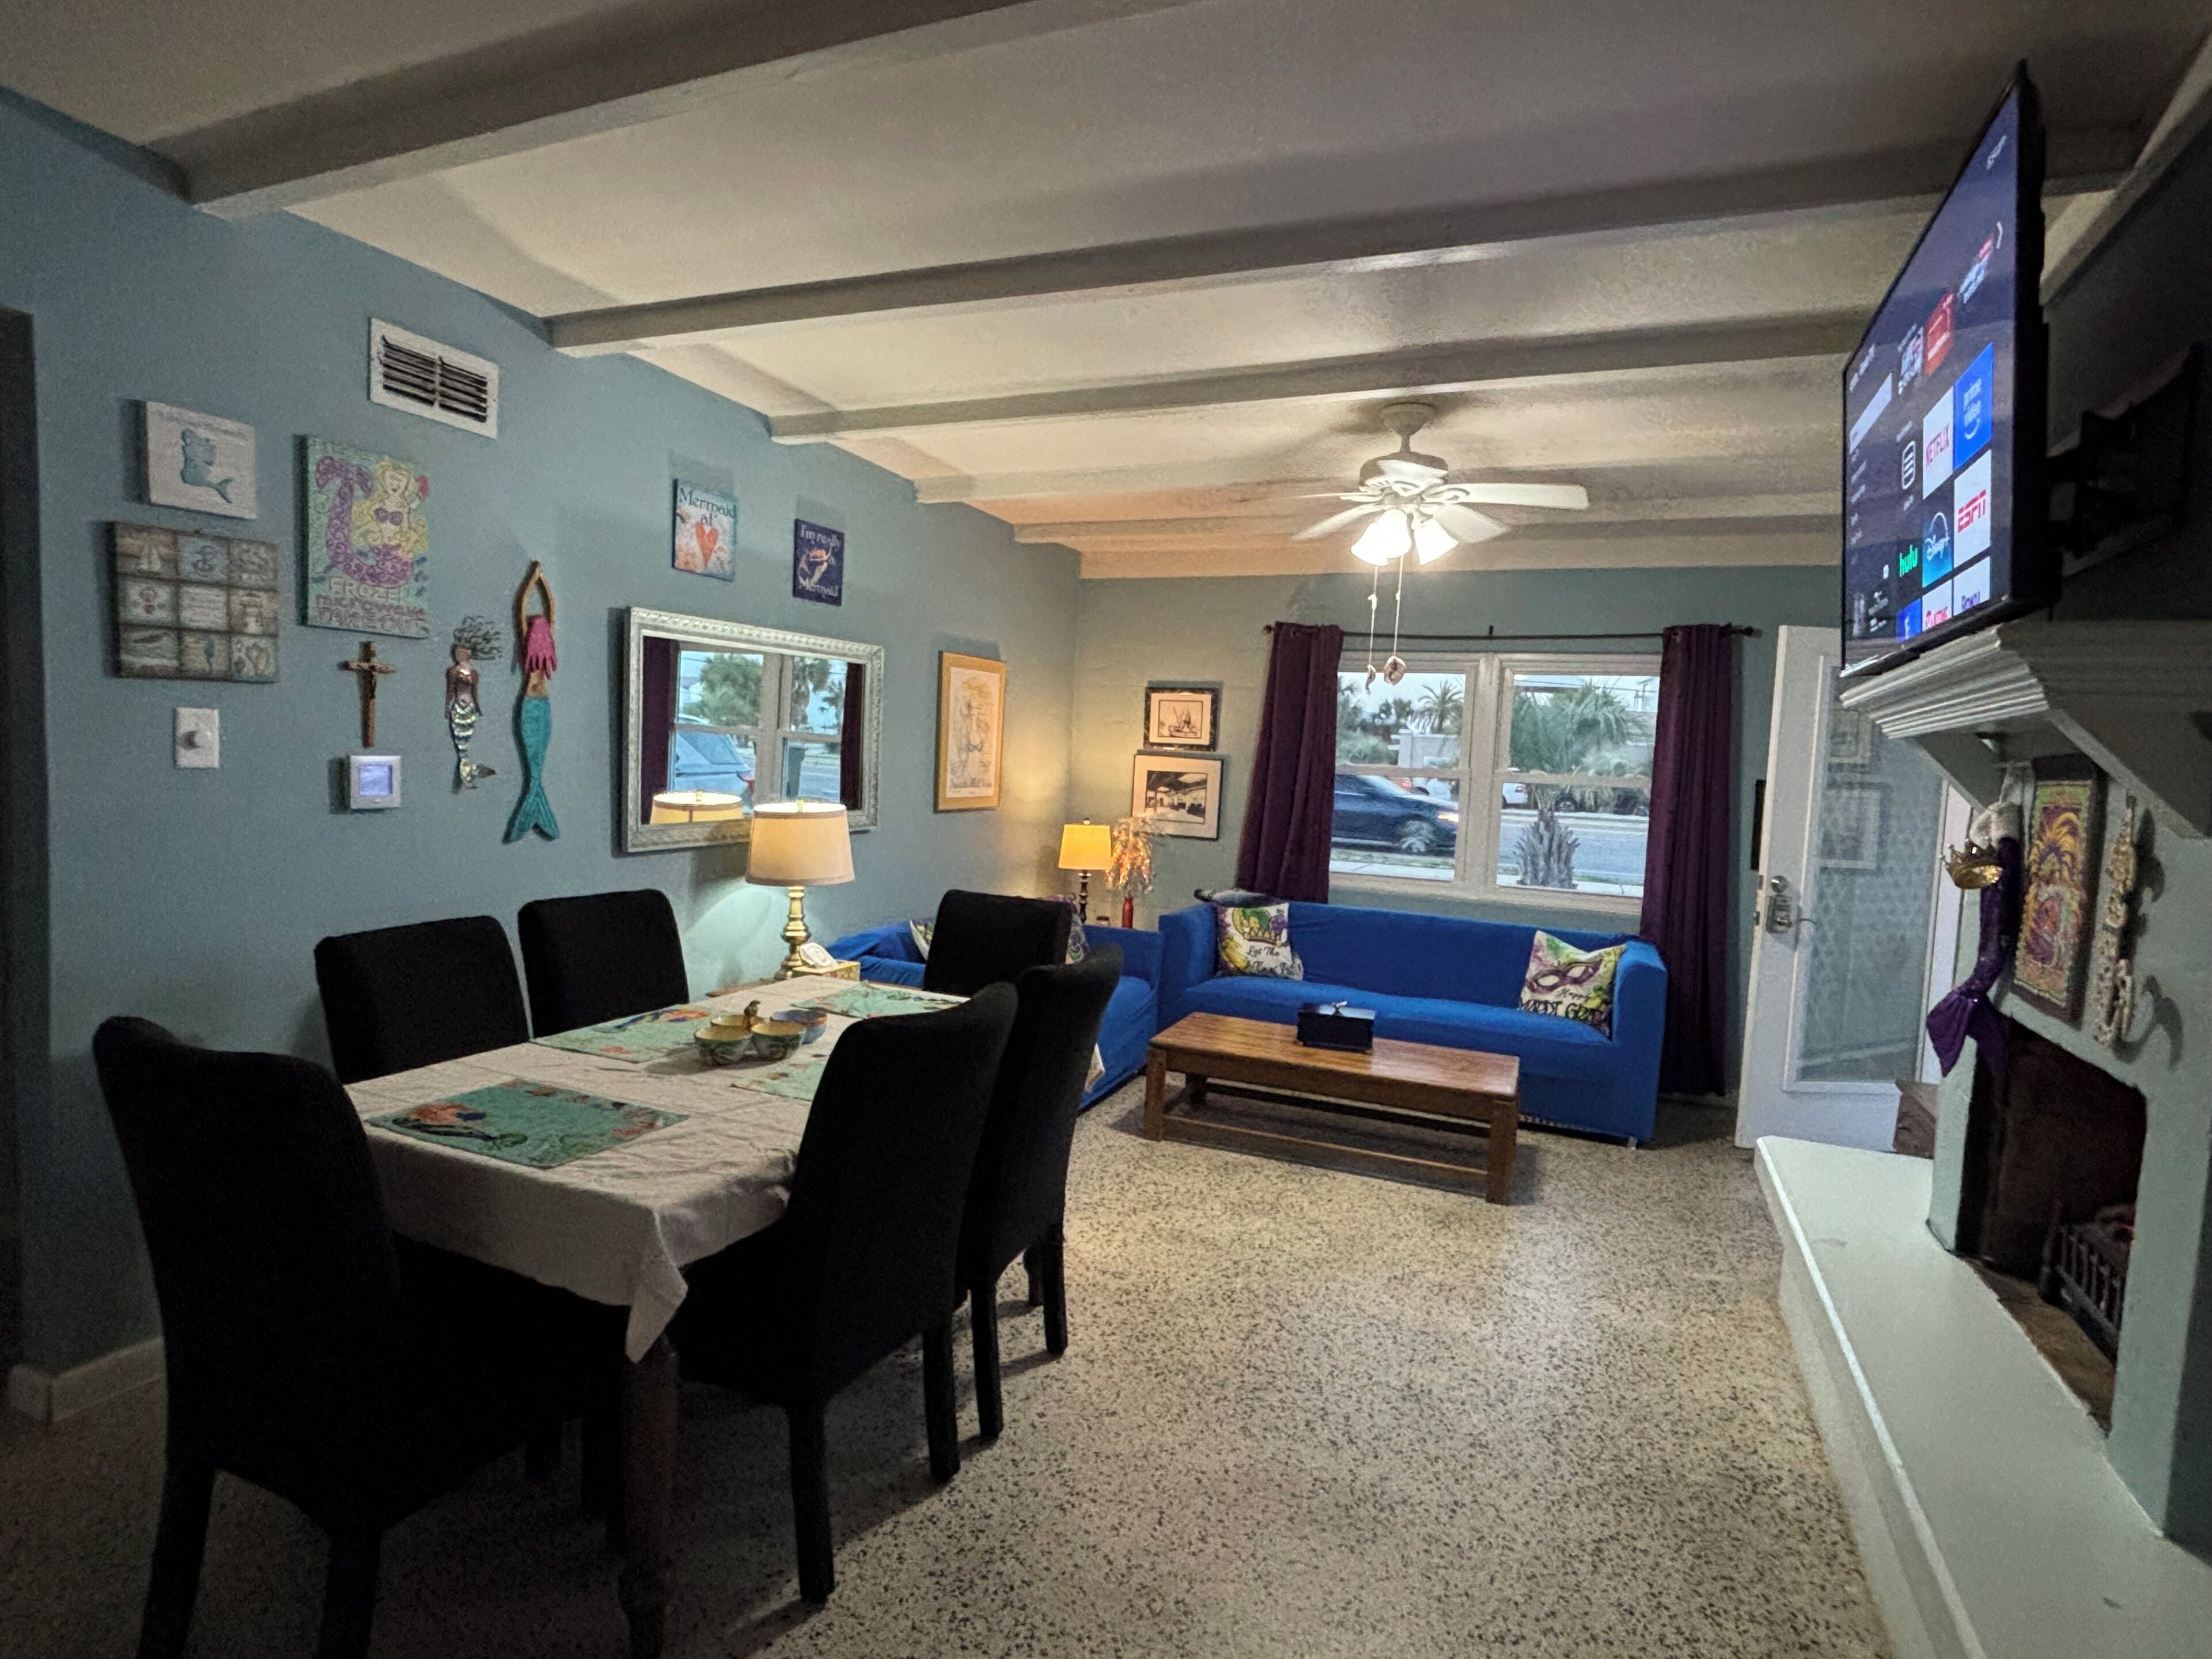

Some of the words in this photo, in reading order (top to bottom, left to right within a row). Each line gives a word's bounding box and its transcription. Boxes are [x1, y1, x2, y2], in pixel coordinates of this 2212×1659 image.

[1925, 422, 1950, 468] NETFLIX
[679, 487, 737, 518] Mermaid
[1958, 489, 1987, 533] ESPN
[800, 524, 816, 545] I'm
[816, 533, 840, 552] really
[1899, 544, 1918, 577] hulu
[798, 577, 839, 599] Mermaid
